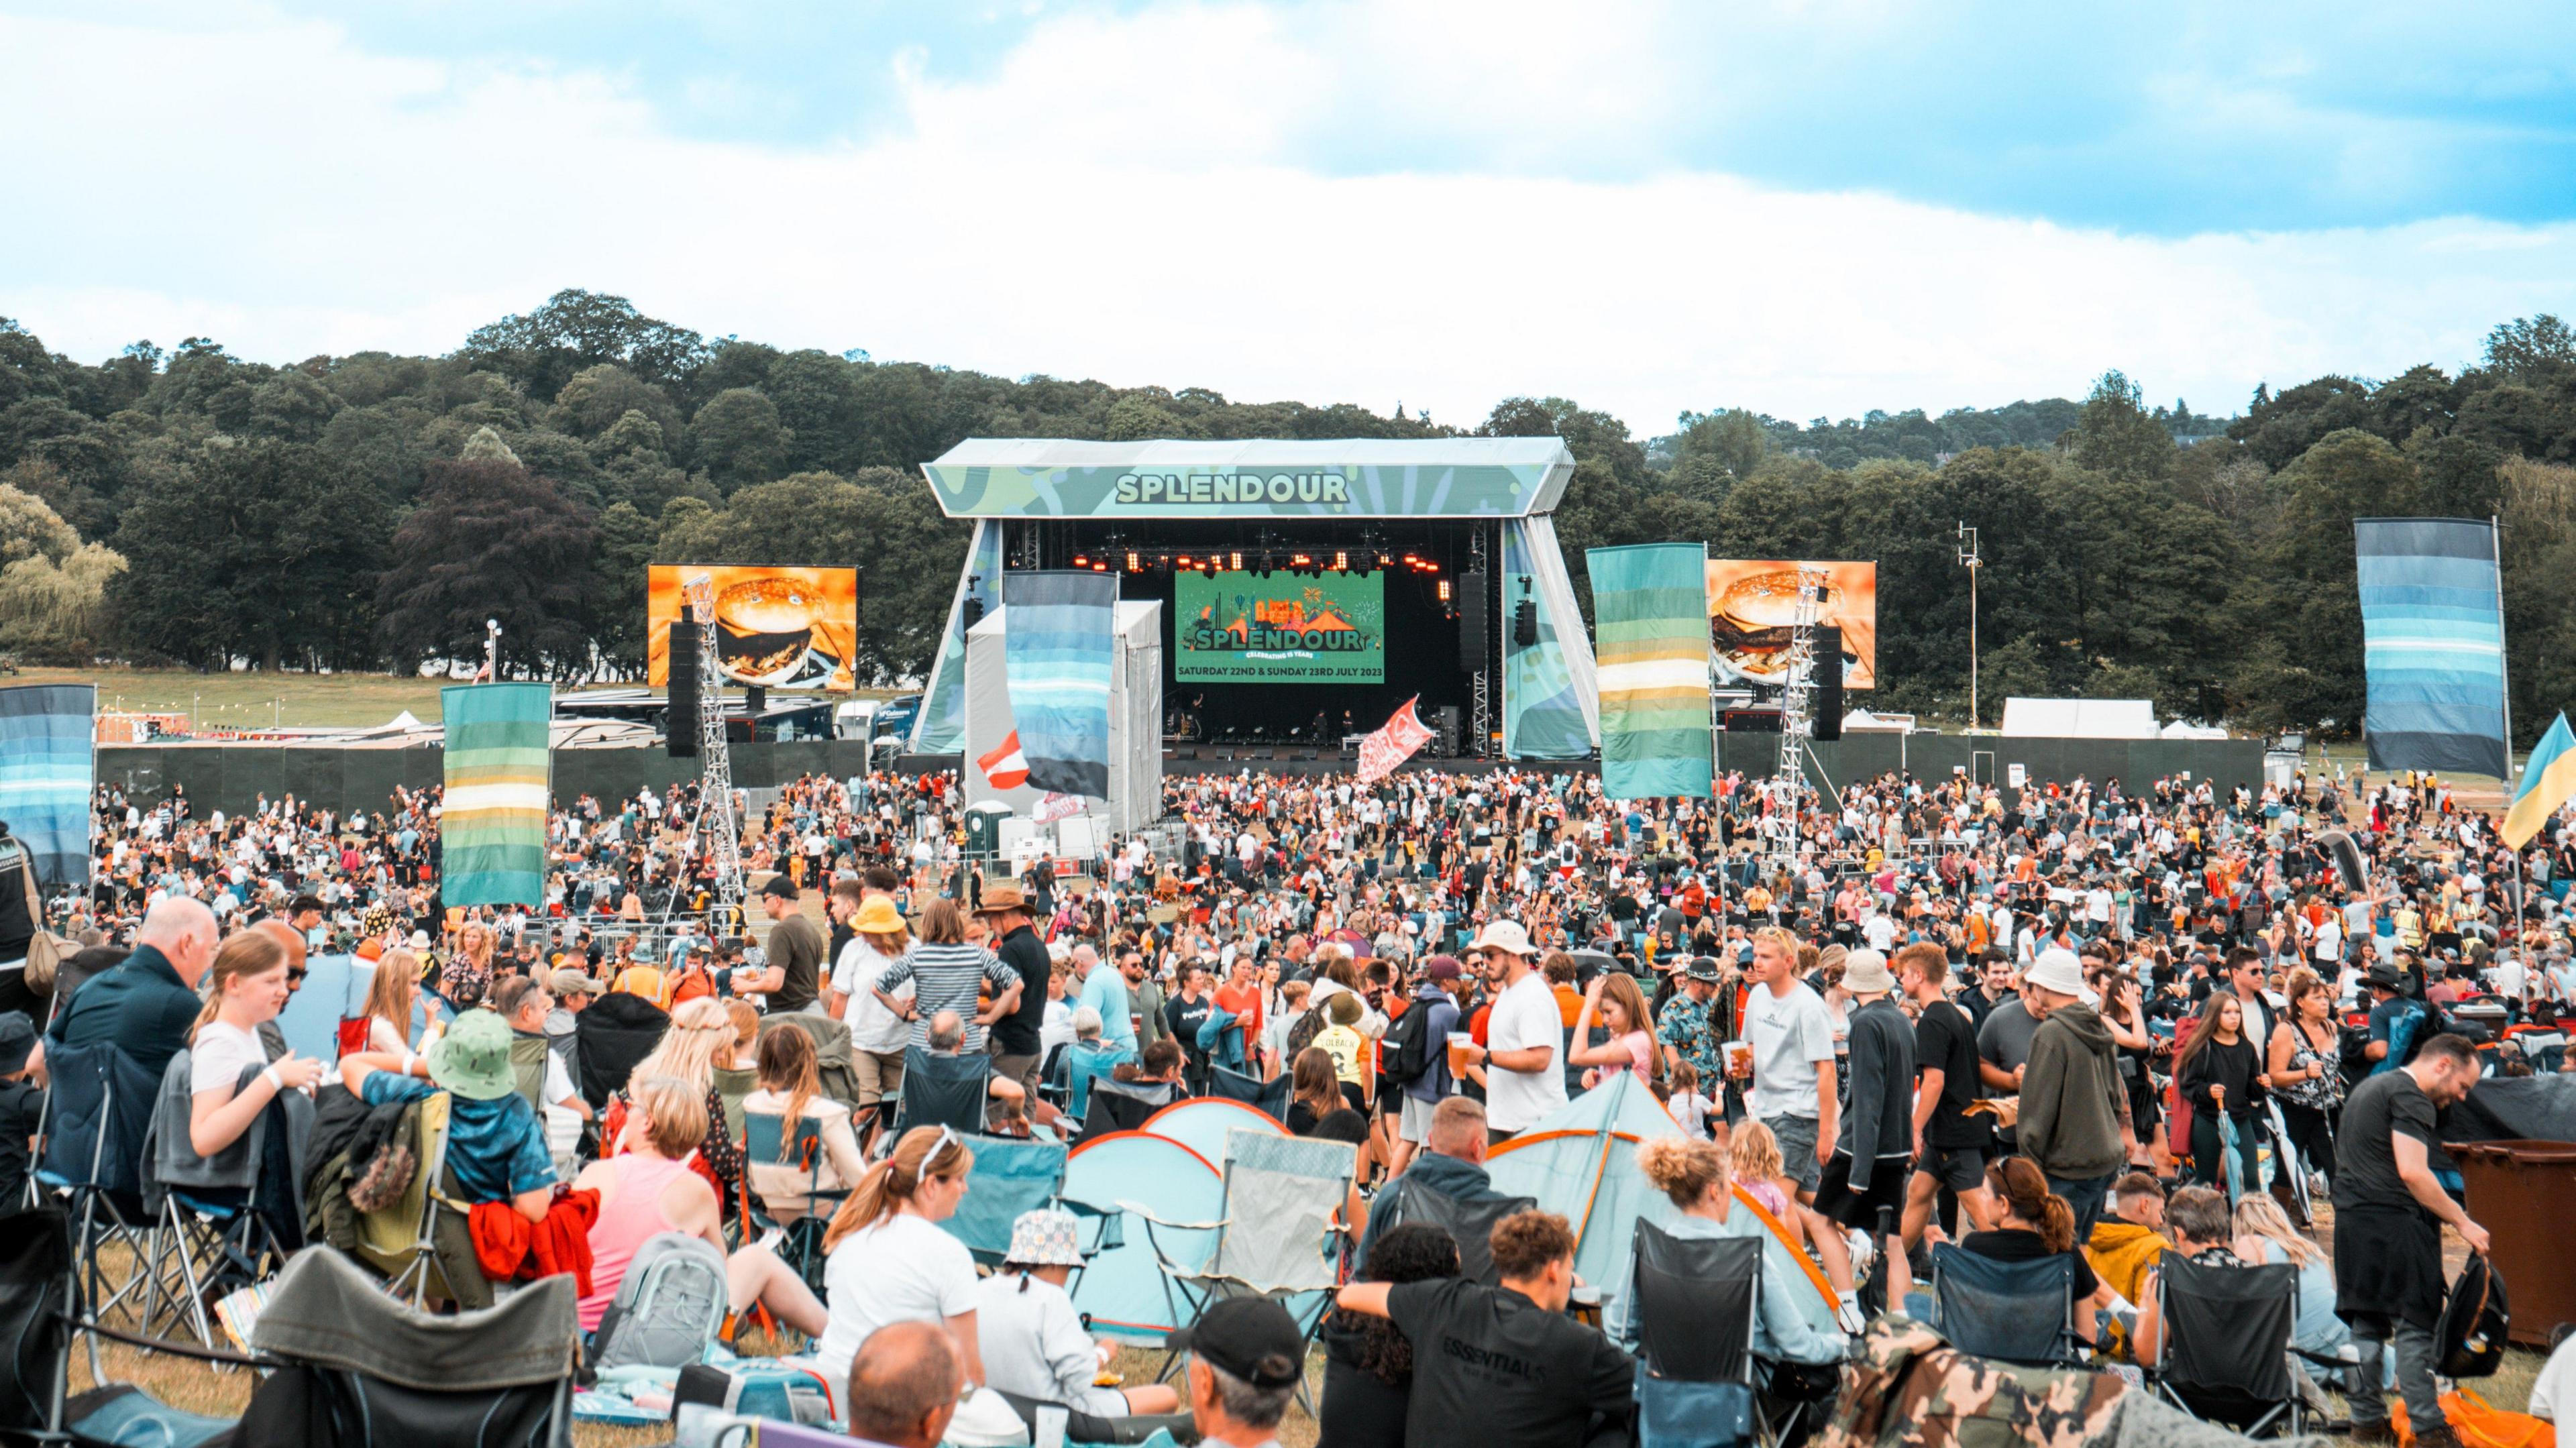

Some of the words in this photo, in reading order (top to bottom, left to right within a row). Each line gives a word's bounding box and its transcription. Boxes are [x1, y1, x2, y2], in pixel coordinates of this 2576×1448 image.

[1116, 474, 1348, 503] SPLENDOUR
[1196, 629, 1362, 651] SPLENDOUR
[1246, 651, 1287, 660] CELEBRATING
[1293, 651, 1313, 659] YEARS
[1178, 667, 1228, 675] SATURDAY
[1230, 667, 1256, 676] 22ND
[1258, 667, 1265, 676] &
[1267, 667, 1307, 676] SUNDAY
[1309, 667, 1334, 677] 23RD
[1336, 668, 1358, 677] JULY
[1360, 668, 1383, 677] 2023
[1443, 1336, 1547, 1383] ESSENTIALS
